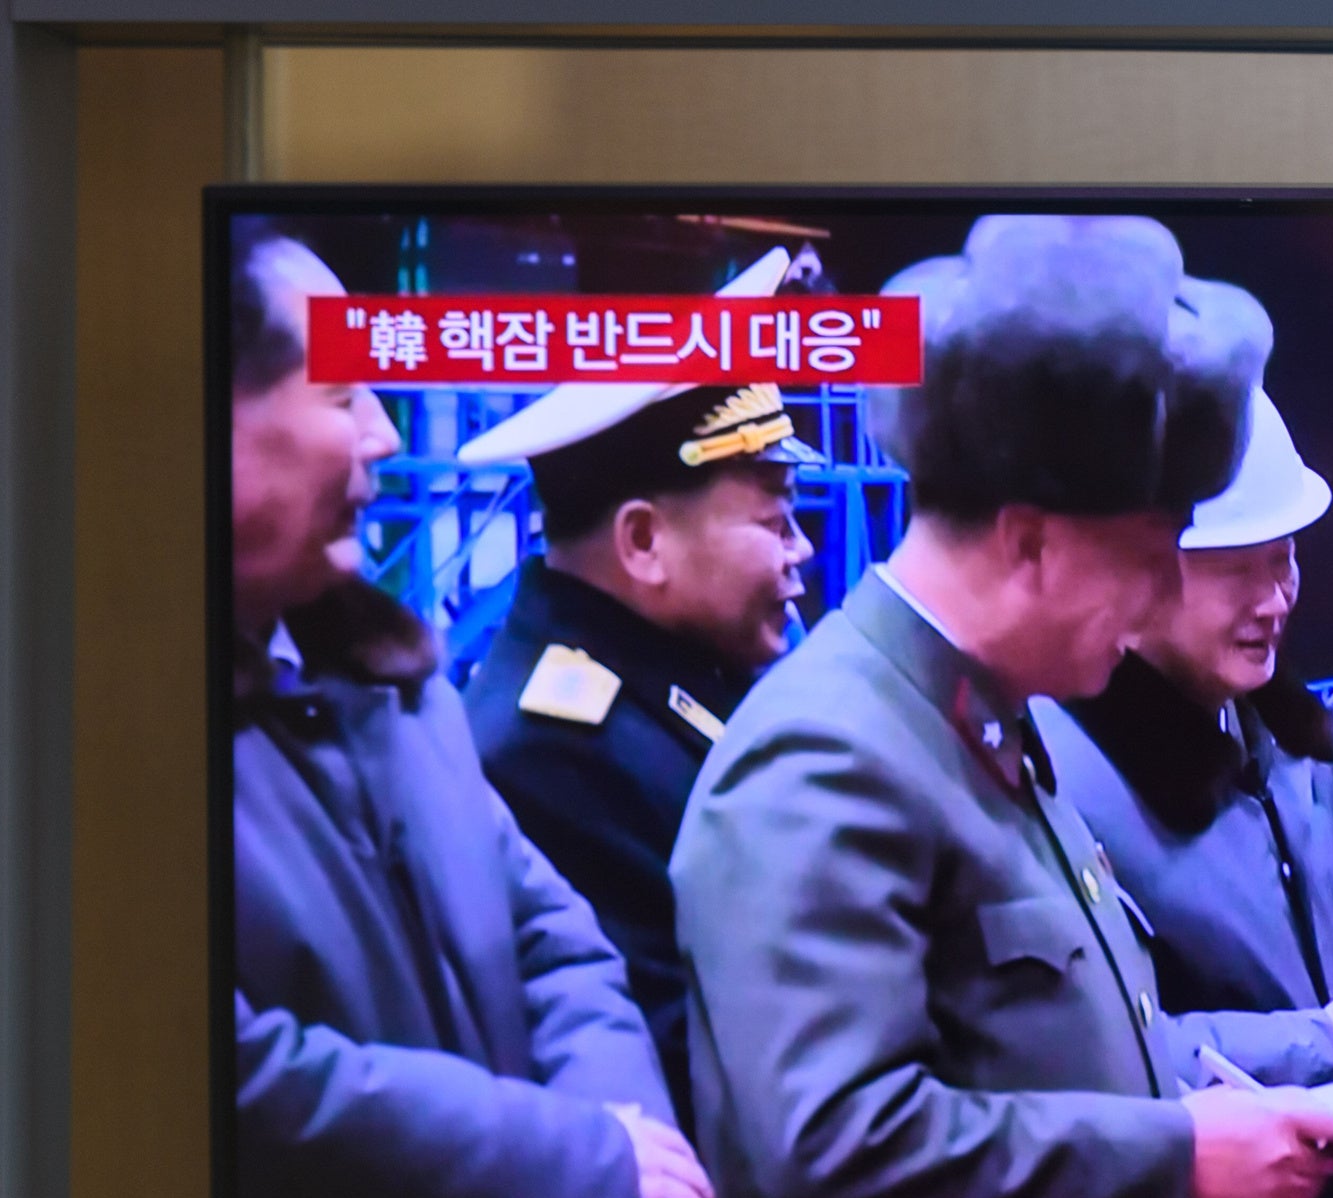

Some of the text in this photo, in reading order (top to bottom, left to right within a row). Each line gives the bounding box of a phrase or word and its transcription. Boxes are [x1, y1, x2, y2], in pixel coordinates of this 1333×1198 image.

[438, 310, 554, 372] 핵잠
[566, 310, 732, 372] 반드시
[748, 308, 882, 373] 대응"
